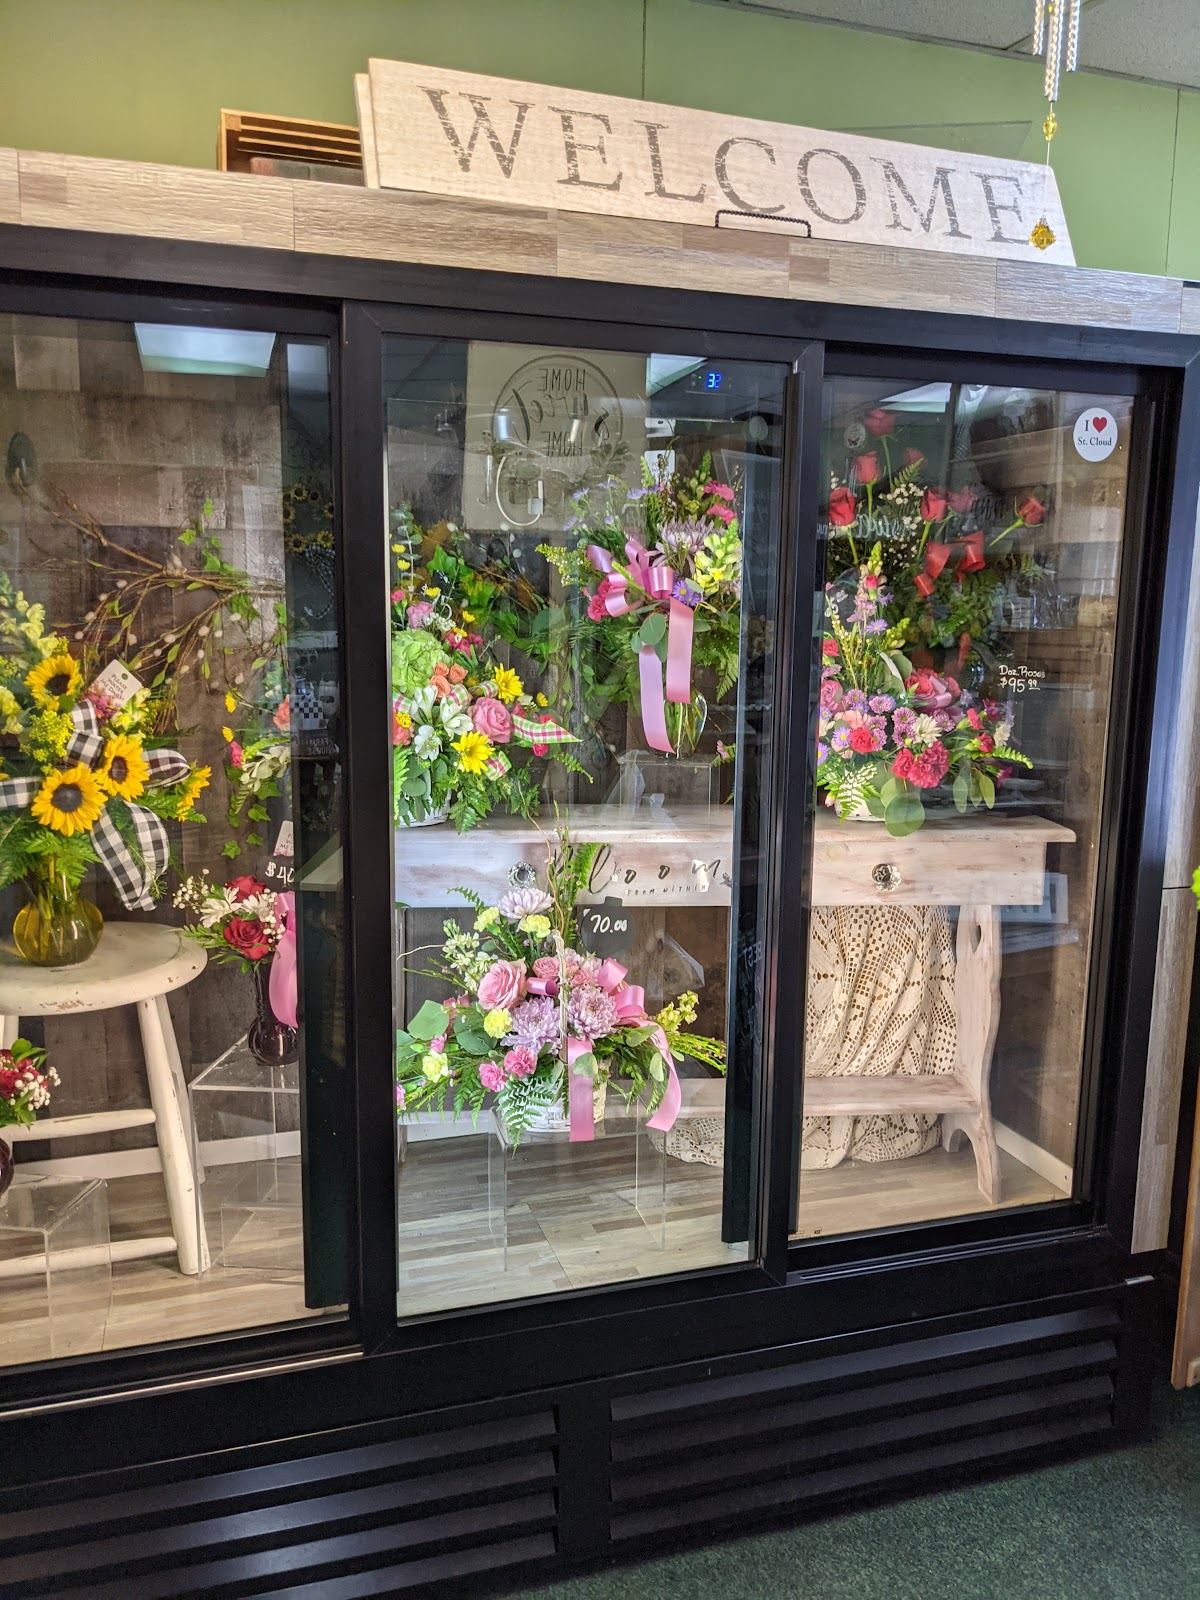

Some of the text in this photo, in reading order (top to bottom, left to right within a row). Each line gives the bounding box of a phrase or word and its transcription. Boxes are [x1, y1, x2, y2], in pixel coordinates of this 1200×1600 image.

[417, 85, 1034, 246] WELCOME
[1085, 419, 1089, 431] I
[1077, 436, 1112, 446] St. Cloud
[590, 914, 628, 934] 70.00
